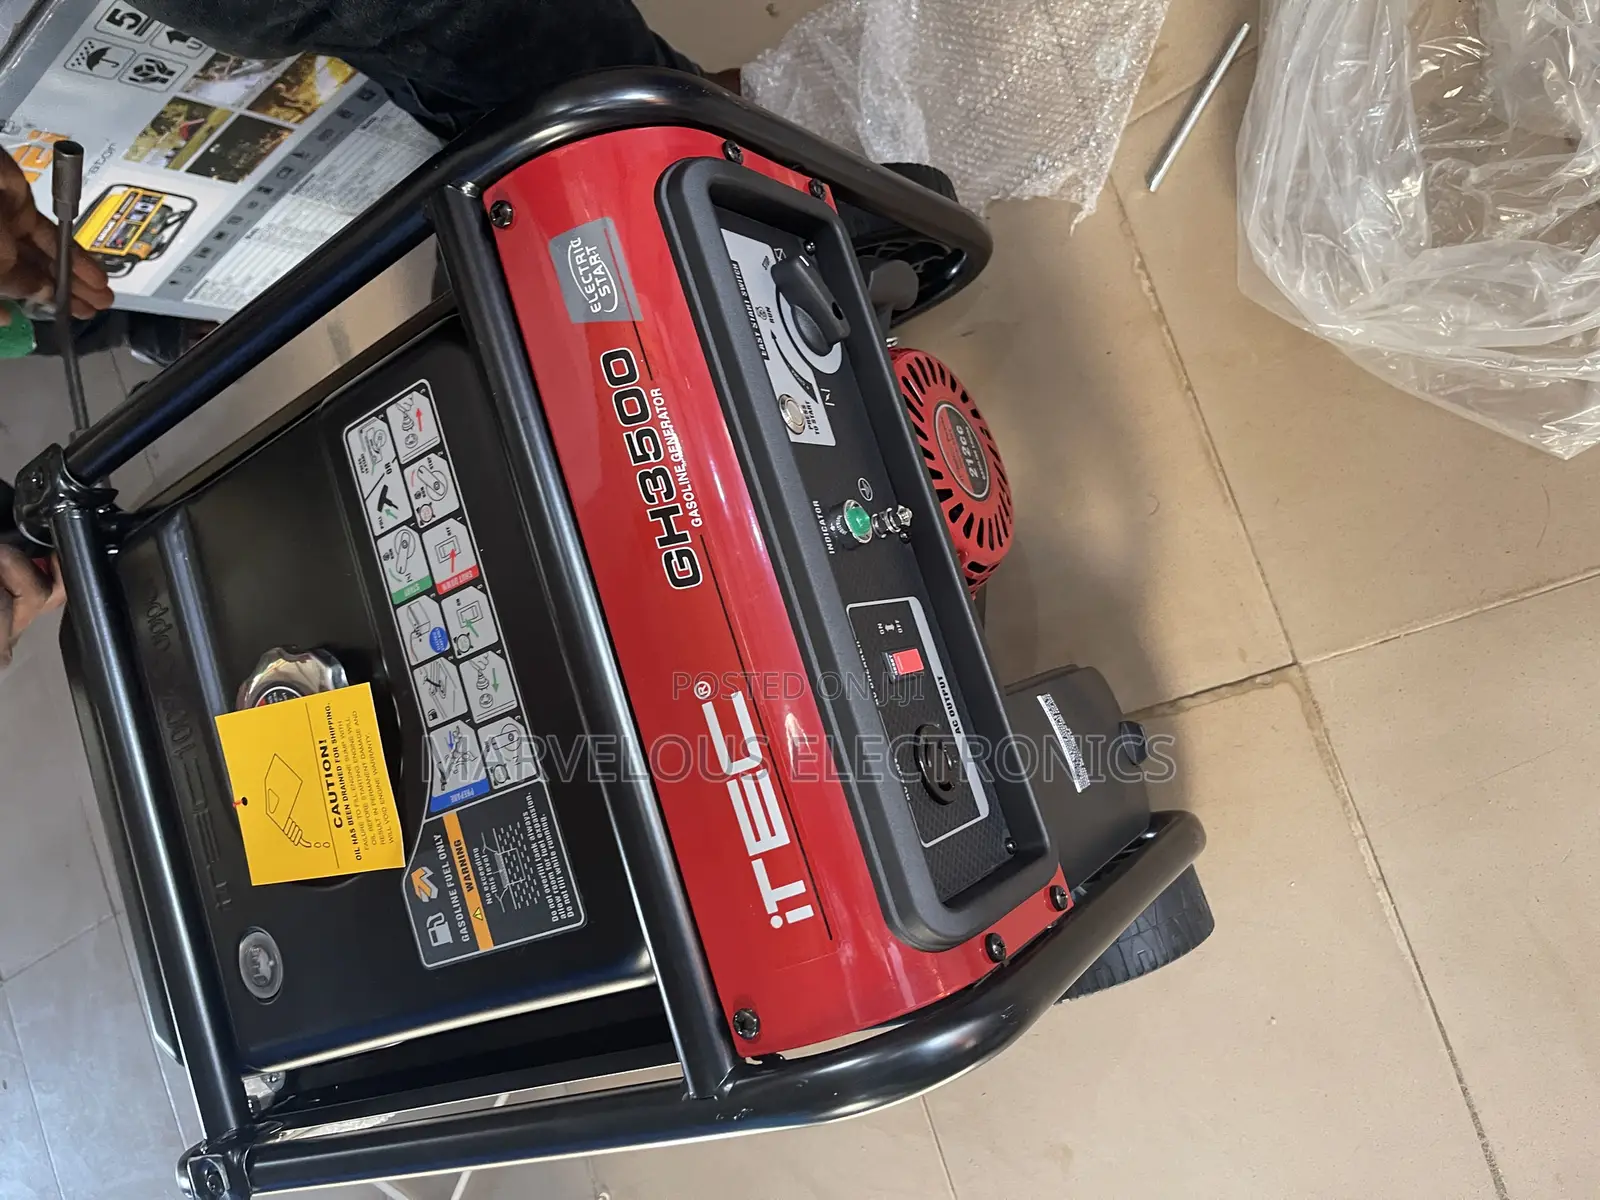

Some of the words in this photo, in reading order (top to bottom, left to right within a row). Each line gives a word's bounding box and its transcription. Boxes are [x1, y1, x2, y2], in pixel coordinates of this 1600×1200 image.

[106, 3, 143, 31] 5
[569, 236, 602, 313] ELECTRIC
[585, 243, 611, 296] START
[765, 305, 774, 323] RUN
[801, 404, 813, 430] PRESS
[804, 399, 816, 424] START
[650, 387, 684, 462] GENERATOR
[813, 425, 819, 435] TO
[383, 461, 393, 475] OR
[598, 345, 703, 591] GH3500
[672, 463, 703, 527] GASOLINE
[812, 499, 835, 554] INDICATOR
[877, 622, 884, 634] ON
[894, 618, 903, 633] OFF
[936, 674, 955, 717] OUTPUT
[324, 702, 337, 743] SHIPPING.
[336, 720, 345, 738] WITH
[351, 710, 359, 726] AND
[951, 719, 961, 734] AC
[332, 746, 340, 762] FOR
[318, 739, 343, 828] CAUTION!
[336, 765, 348, 801] DRAINED
[345, 764, 356, 790] ENGINE
[361, 762, 376, 805] PERMANENT
[351, 792, 359, 807] FILL
[374, 777, 385, 804] ENGINE
[343, 803, 353, 825] BEEN
[355, 809, 362, 818] TO
[362, 802, 374, 831] BEFORE
[372, 807, 379, 815] IN
[380, 806, 389, 823] VOID
[524, 792, 544, 838] expansion.
[701, 690, 815, 929] iTEC
[349, 827, 358, 844] HAS
[357, 821, 369, 850] FAILURE
[374, 817, 386, 845] RESULT
[385, 825, 394, 844] WILL
[521, 810, 536, 841] always
[539, 812, 555, 849] running.
[369, 833, 377, 845] OIL
[433, 833, 447, 859] ONLY
[537, 839, 548, 856] fuel
[354, 846, 362, 860] OIL
[530, 842, 541, 861] tank
[542, 857, 552, 870] for
[548, 850, 561, 874] while
[440, 861, 454, 887] FUEL
[452, 839, 474, 892] WARNING
[471, 847, 489, 892] exceeding
[481, 853, 492, 875] level
[535, 862, 551, 893] overfill
[547, 871, 559, 893] room
[483, 892, 493, 904] No
[545, 894, 555, 908] not
[553, 895, 566, 919] allow
[560, 889, 570, 904] not
[448, 888, 470, 941] GASOLINE
[549, 910, 559, 921] Do
[564, 905, 574, 917] Do
